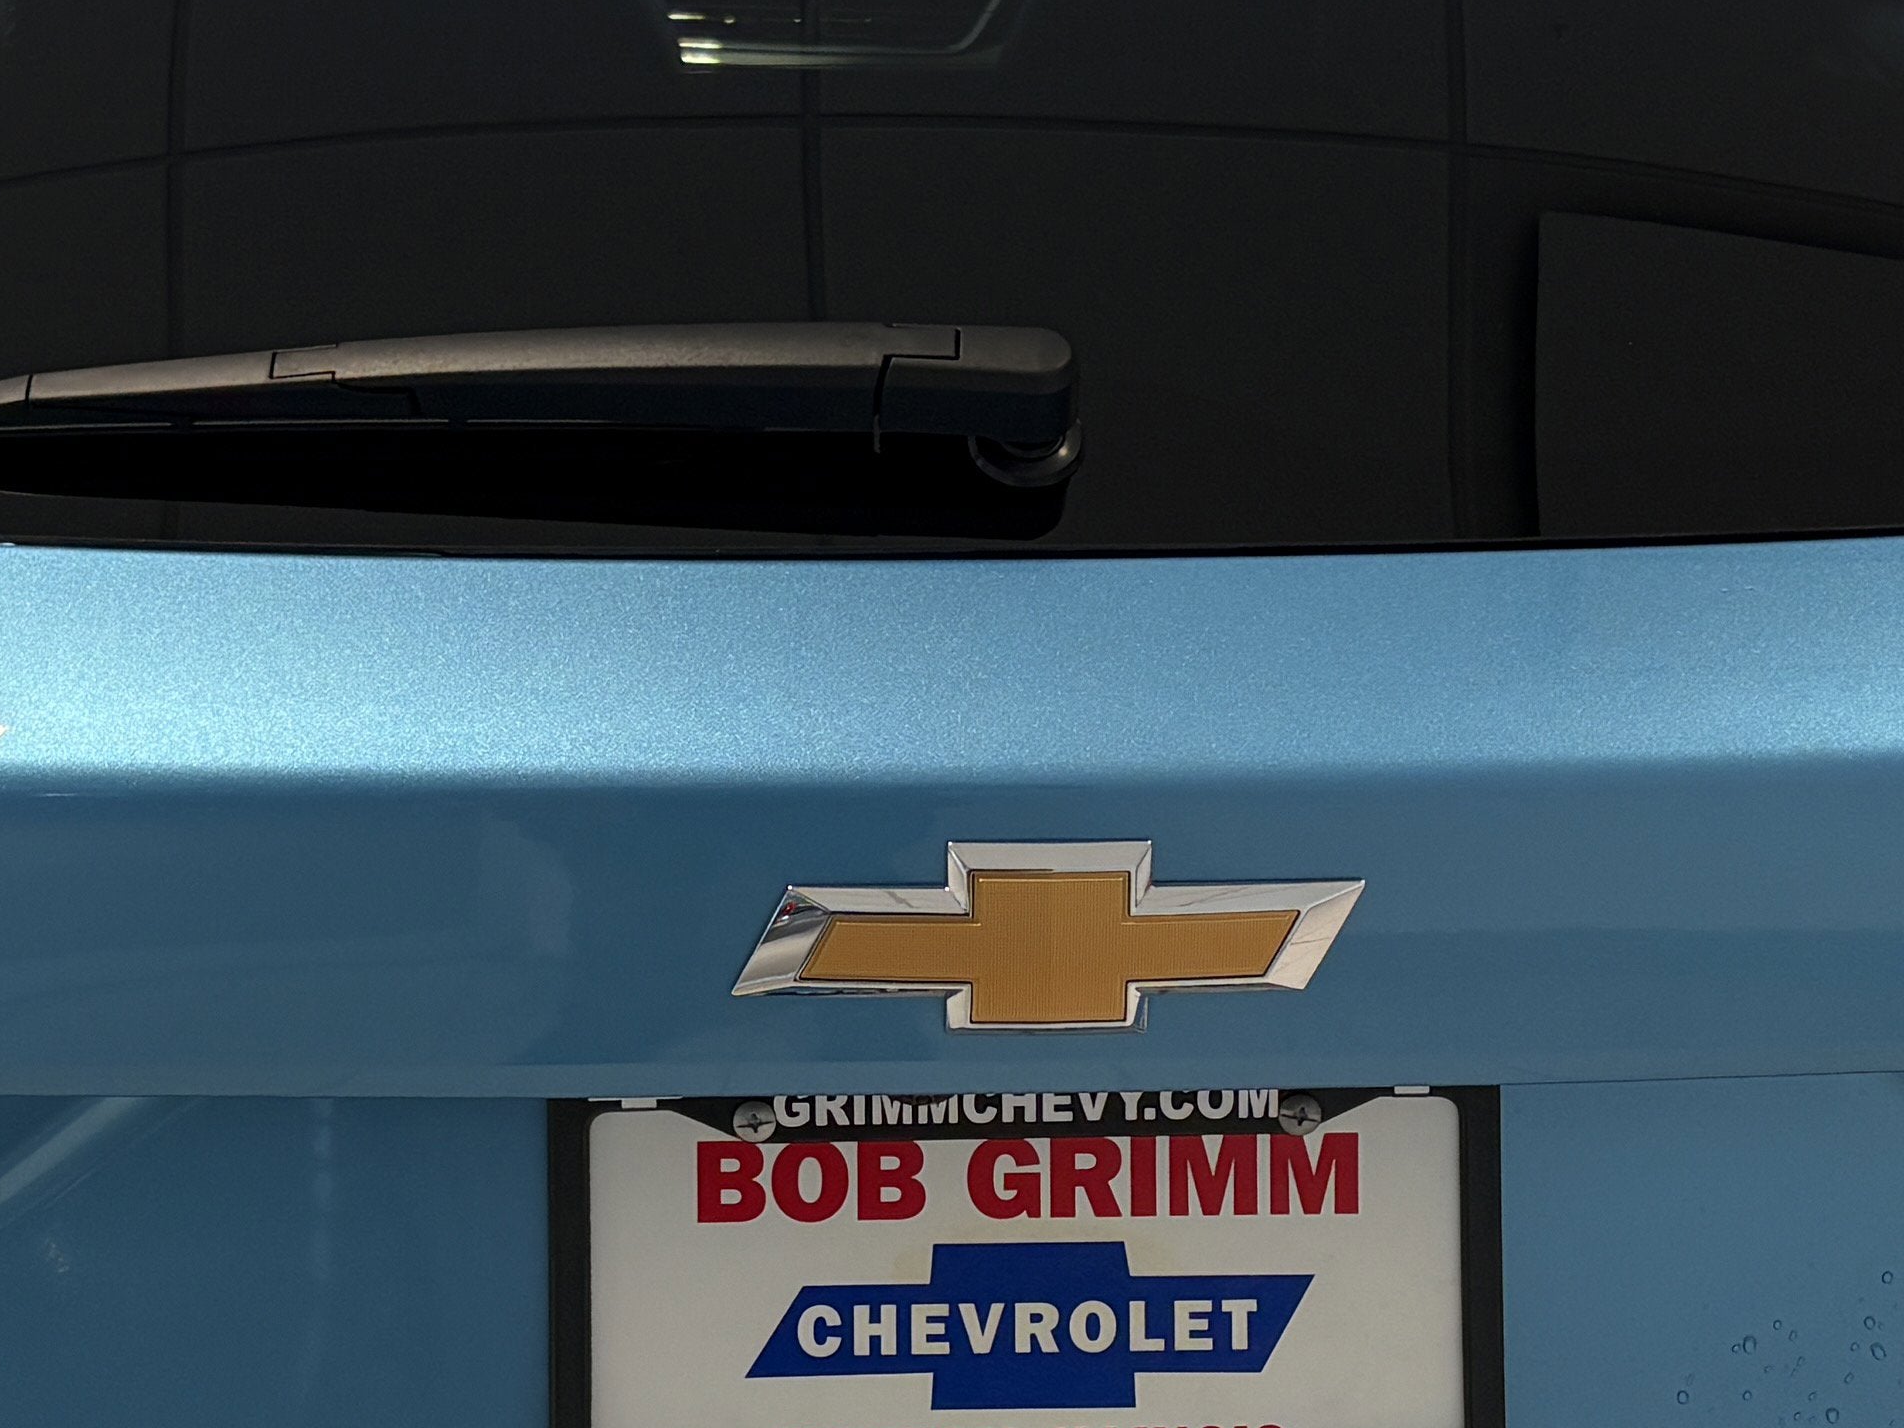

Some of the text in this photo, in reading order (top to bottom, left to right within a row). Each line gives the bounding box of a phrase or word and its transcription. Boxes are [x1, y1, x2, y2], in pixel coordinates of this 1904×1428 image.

[773, 1090, 1279, 1126] GRIMMCHEVY.COM
[696, 1132, 1359, 1224] BOB GRIMM
[797, 1299, 1258, 1357] CHEVROLET
